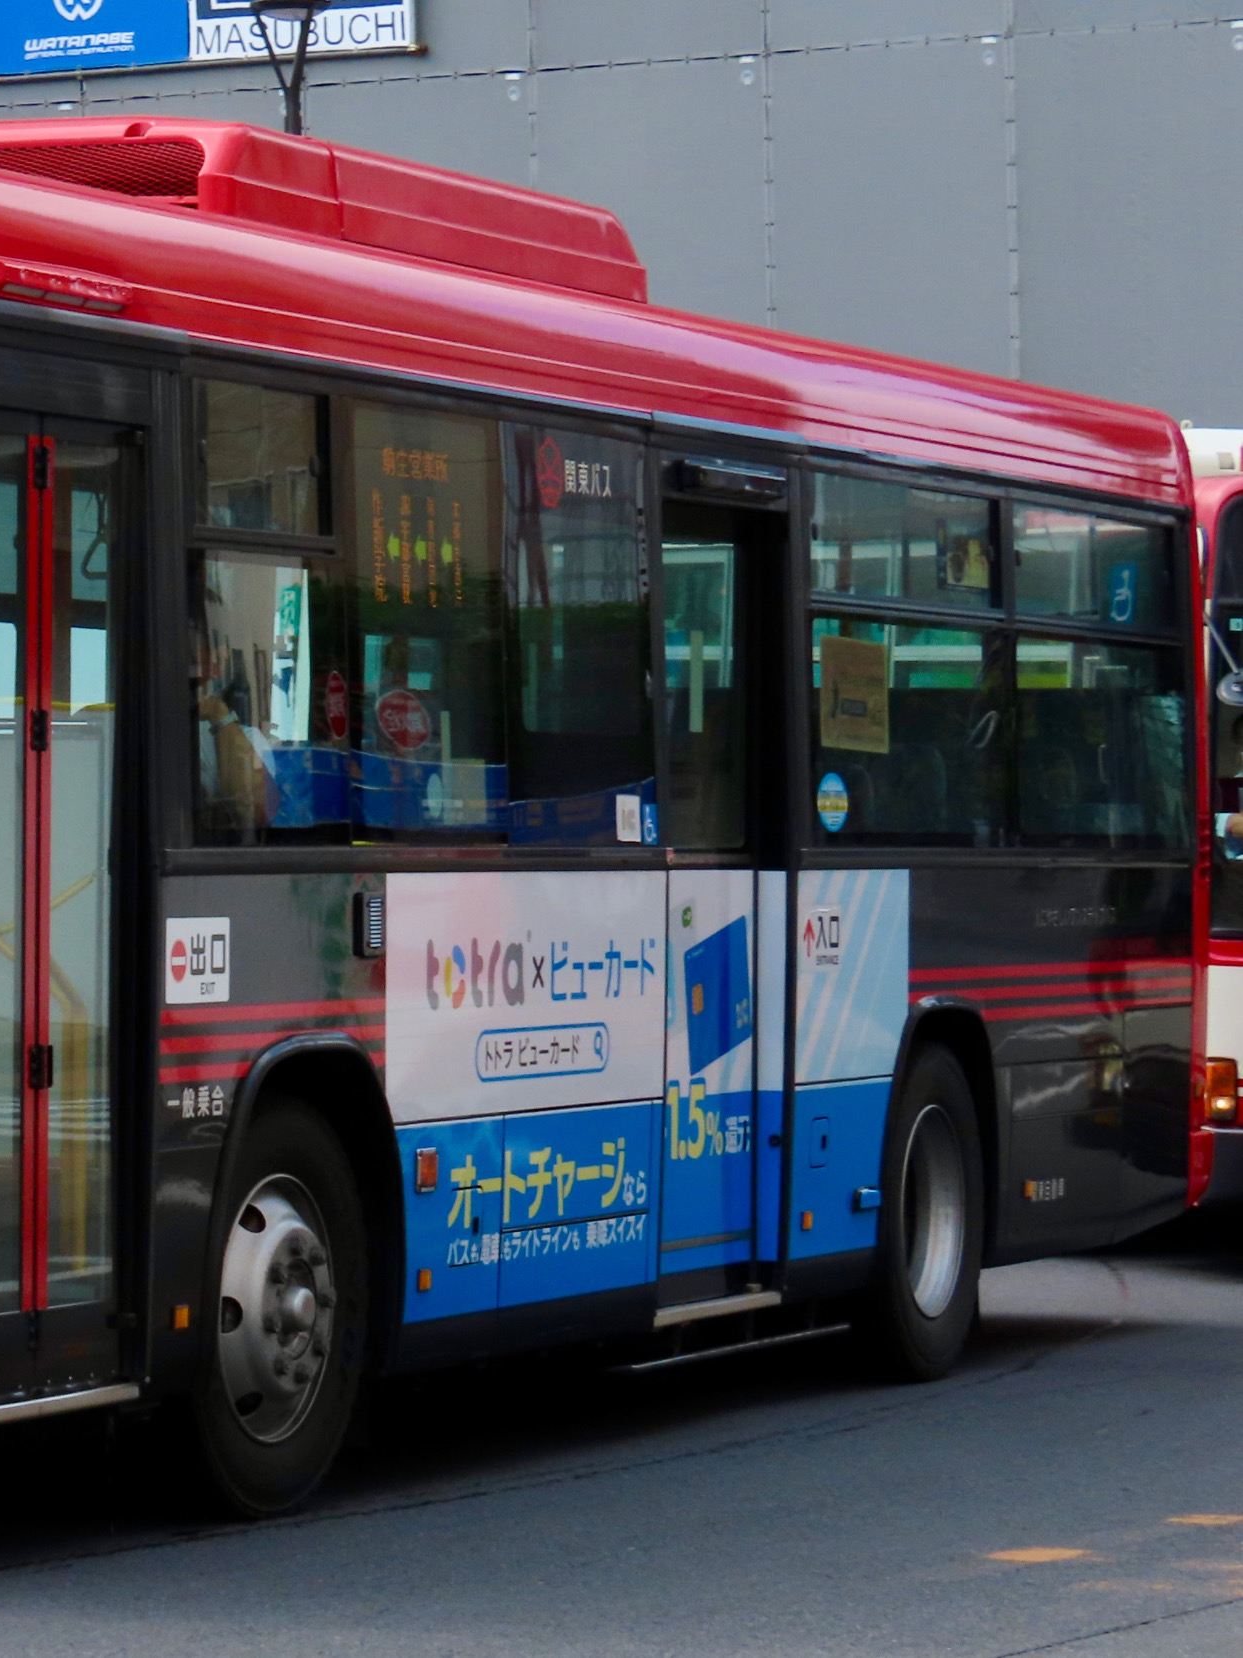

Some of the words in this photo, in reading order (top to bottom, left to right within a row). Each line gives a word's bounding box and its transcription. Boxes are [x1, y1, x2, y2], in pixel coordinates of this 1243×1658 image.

[24, 31, 135, 52] WATANABE
[564, 459, 613, 499] 関東バス
[816, 916, 840, 949] 入口
[190, 933, 226, 976] 出口
[200, 982, 216, 995] EXIT
[427, 937, 525, 1010] totra
[551, 938, 656, 1001] ビューカード
[485, 1040, 513, 1072] トトラ
[519, 1035, 580, 1068] ビューカード
[167, 1085, 225, 1118] 一般乗合
